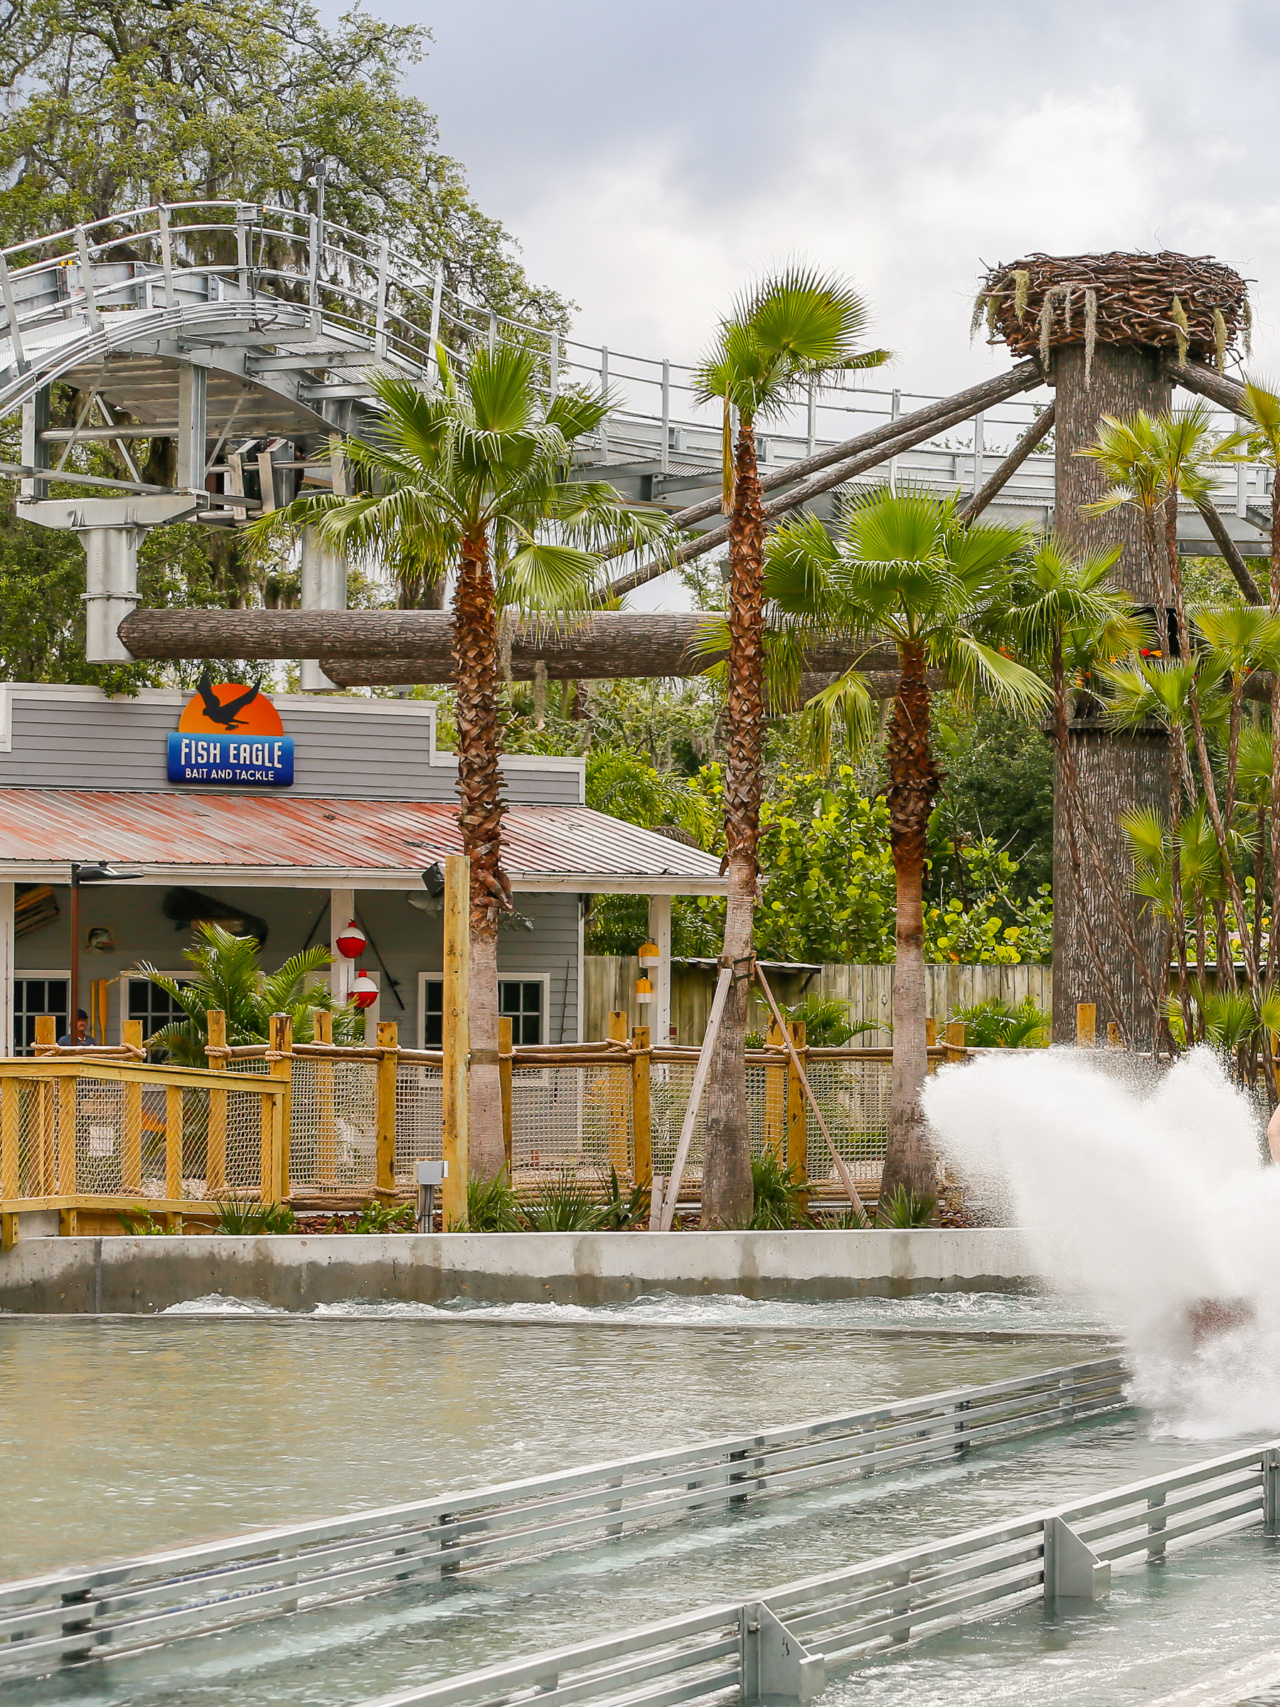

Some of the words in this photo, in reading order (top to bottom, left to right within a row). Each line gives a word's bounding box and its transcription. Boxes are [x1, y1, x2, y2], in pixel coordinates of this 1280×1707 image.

[181, 738, 221, 765] FISH
[229, 742, 282, 768] EAGLE
[185, 768, 208, 779] BAIT
[210, 769, 233, 780] AND
[235, 769, 275, 781] TACKLE
